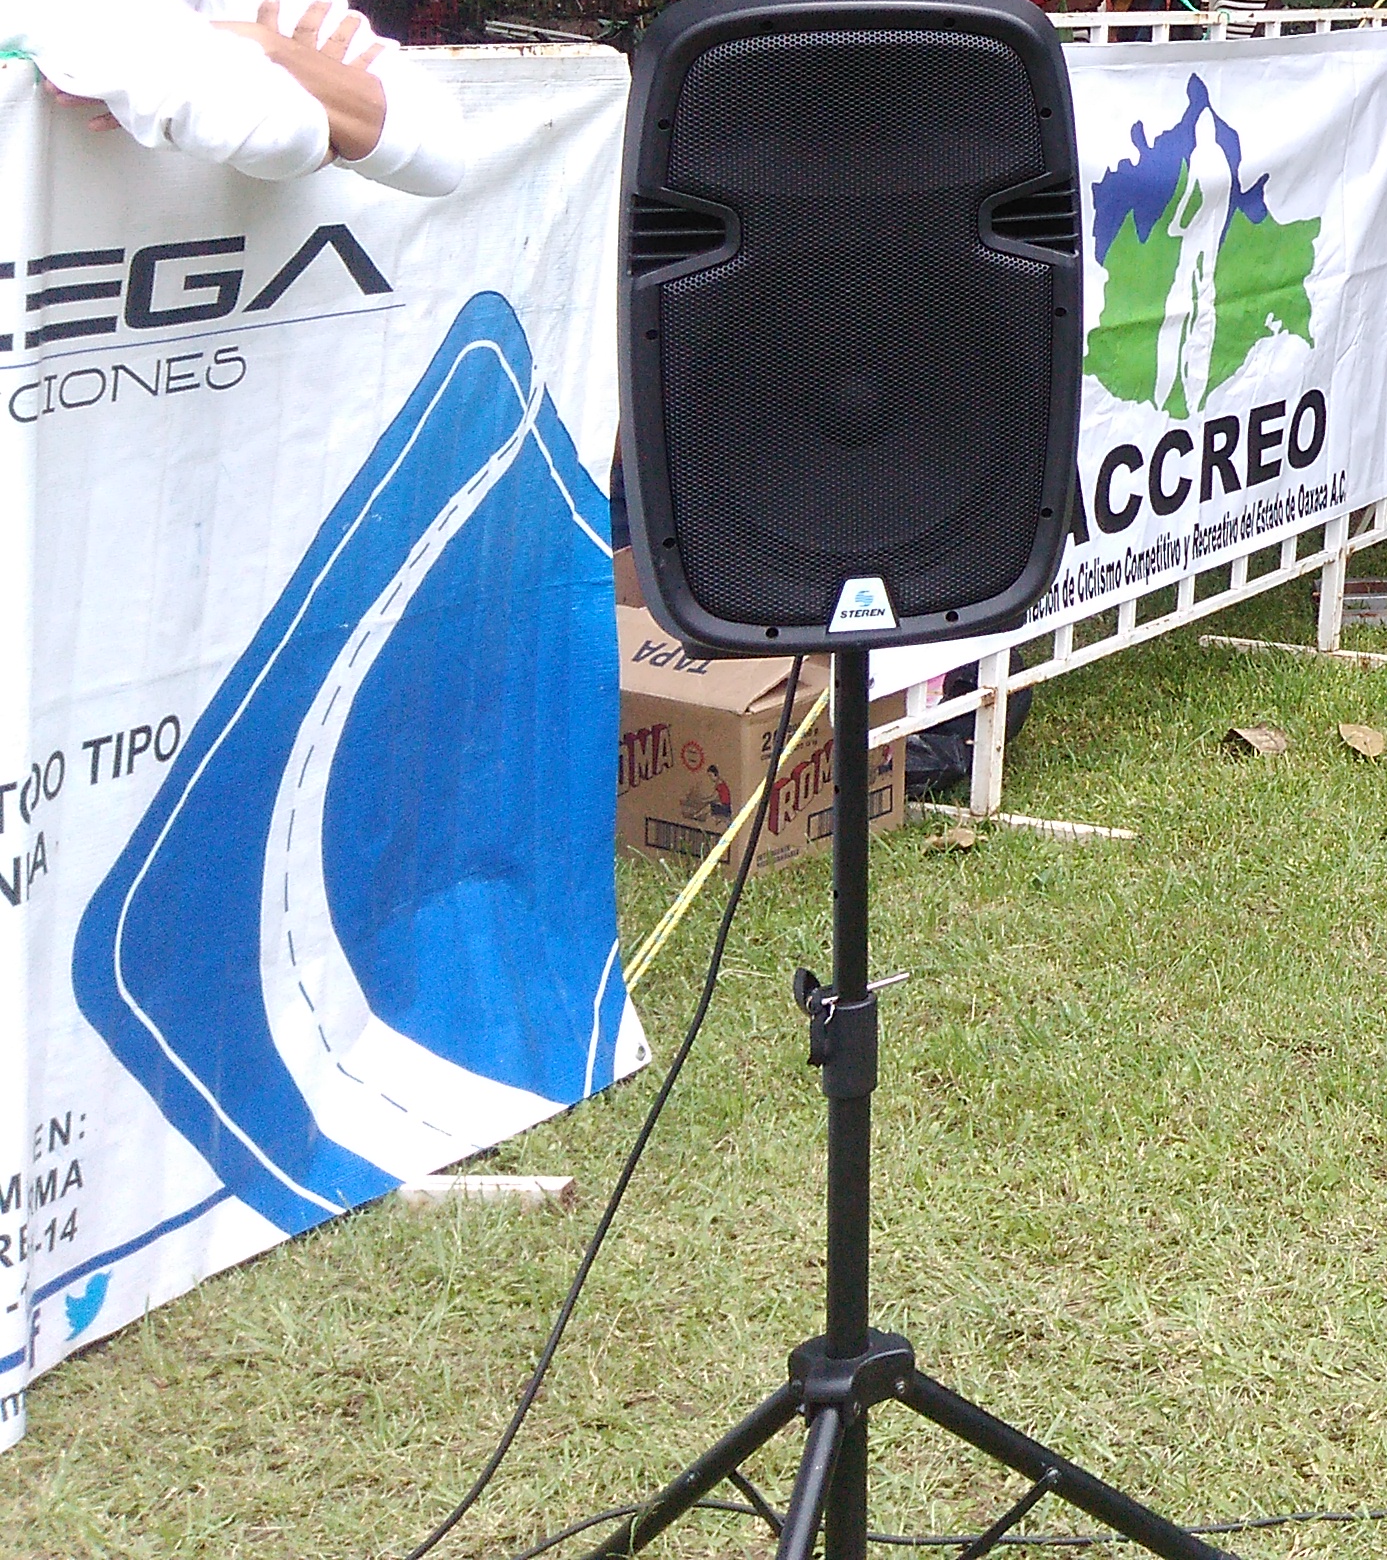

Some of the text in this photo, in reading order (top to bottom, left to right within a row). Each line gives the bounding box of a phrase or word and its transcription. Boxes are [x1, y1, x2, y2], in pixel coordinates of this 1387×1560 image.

[1062, 570, 1075, 608] de
[1077, 559, 1123, 603] Ciclismo
[1124, 532, 1182, 585] Competitivo
[1182, 533, 1191, 571] y
[1192, 511, 1239, 560] Recreativo
[1239, 503, 1256, 539] del
[1256, 493, 1284, 534] Estado
[1285, 491, 1297, 523] de
[1297, 483, 1329, 518] Oaxaca
[840, 608, 886, 619] STEREN
[631, 639, 710, 676] TAPA
[81, 714, 181, 786] TIPO
